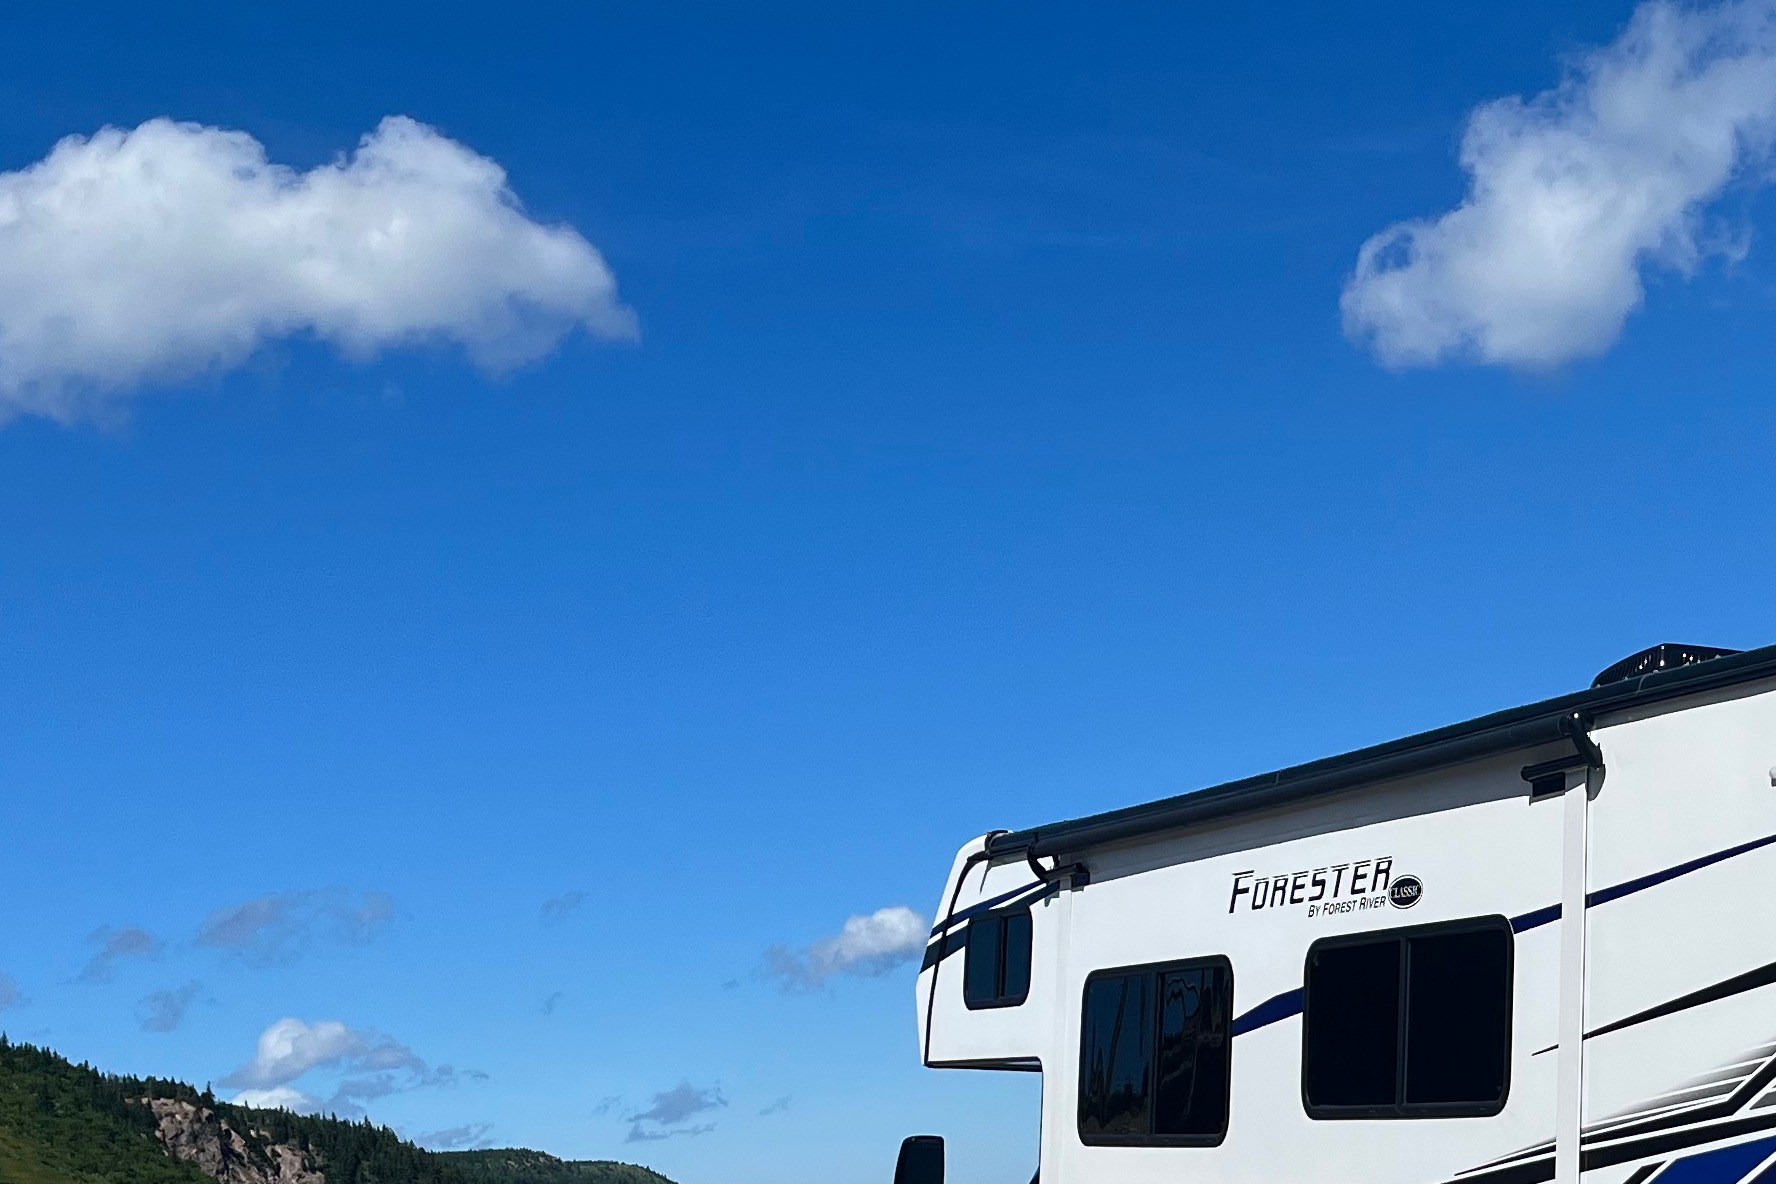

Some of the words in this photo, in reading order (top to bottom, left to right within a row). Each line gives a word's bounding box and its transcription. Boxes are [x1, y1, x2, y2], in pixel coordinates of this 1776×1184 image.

[1229, 855, 1393, 914] FORESTER
[1308, 903, 1320, 918] BY
[1322, 900, 1357, 916] FOREST
[1359, 896, 1386, 911] RIVER
